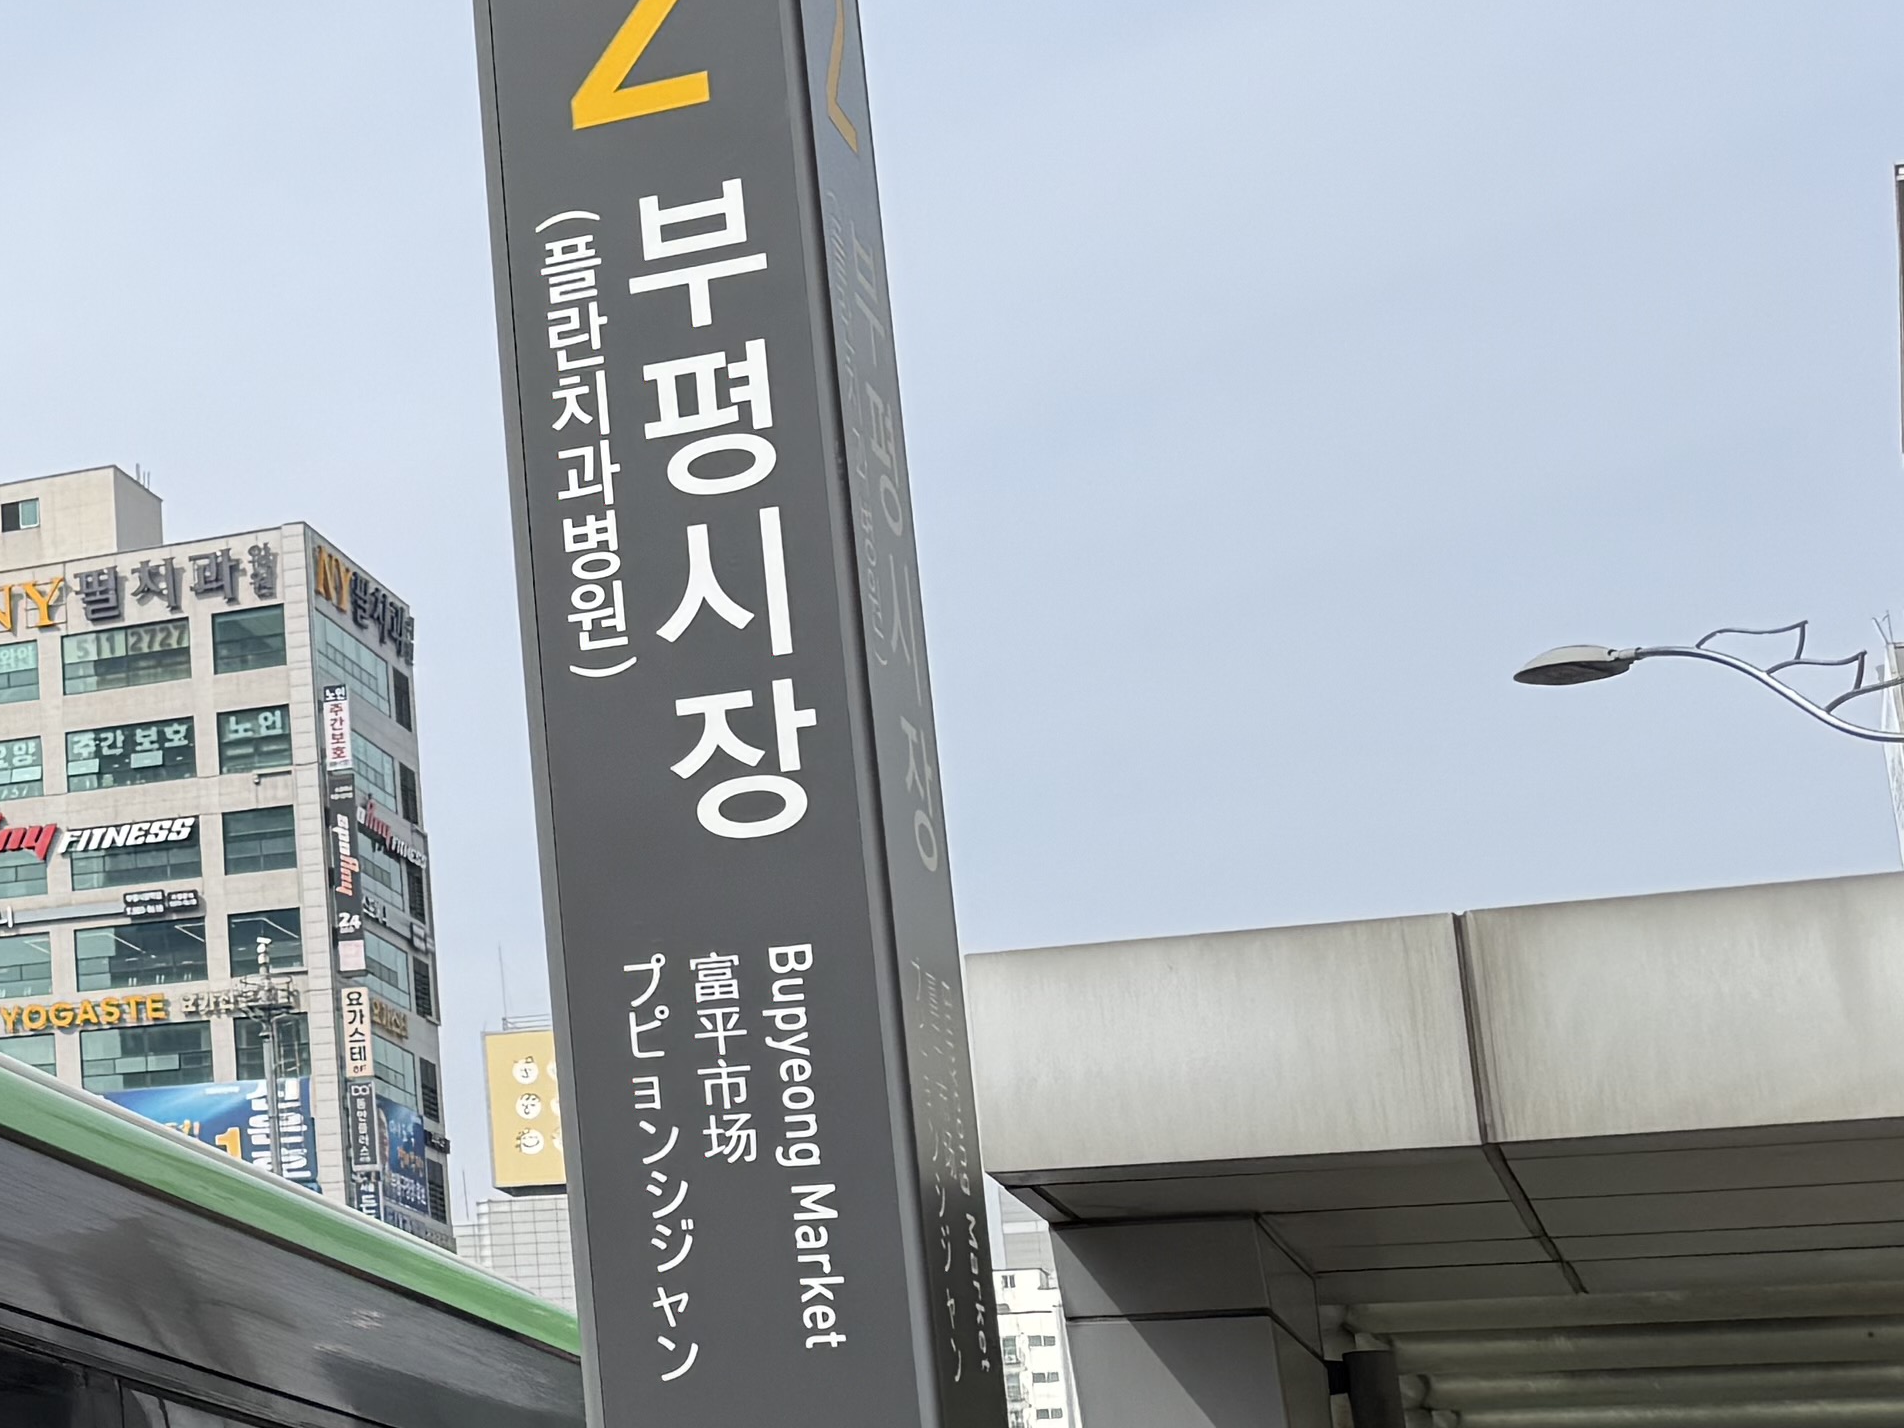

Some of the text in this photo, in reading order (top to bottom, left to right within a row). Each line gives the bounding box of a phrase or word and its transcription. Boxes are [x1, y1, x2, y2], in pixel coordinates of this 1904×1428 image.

[535, 210, 638, 679] (플란치과병원)
[627, 178, 818, 840] 부평시장
[73, 723, 190, 759] 주간 보호
[58, 817, 195, 854] FITNESS
[339, 913, 361, 929] 24
[0, 994, 168, 1034] YOGASTE
[346, 991, 367, 1062] 요가스테
[690, 952, 758, 1164] 富平市场
[624, 953, 699, 1382] プピョンシジャン
[762, 943, 847, 1349] Bupyeong Market
